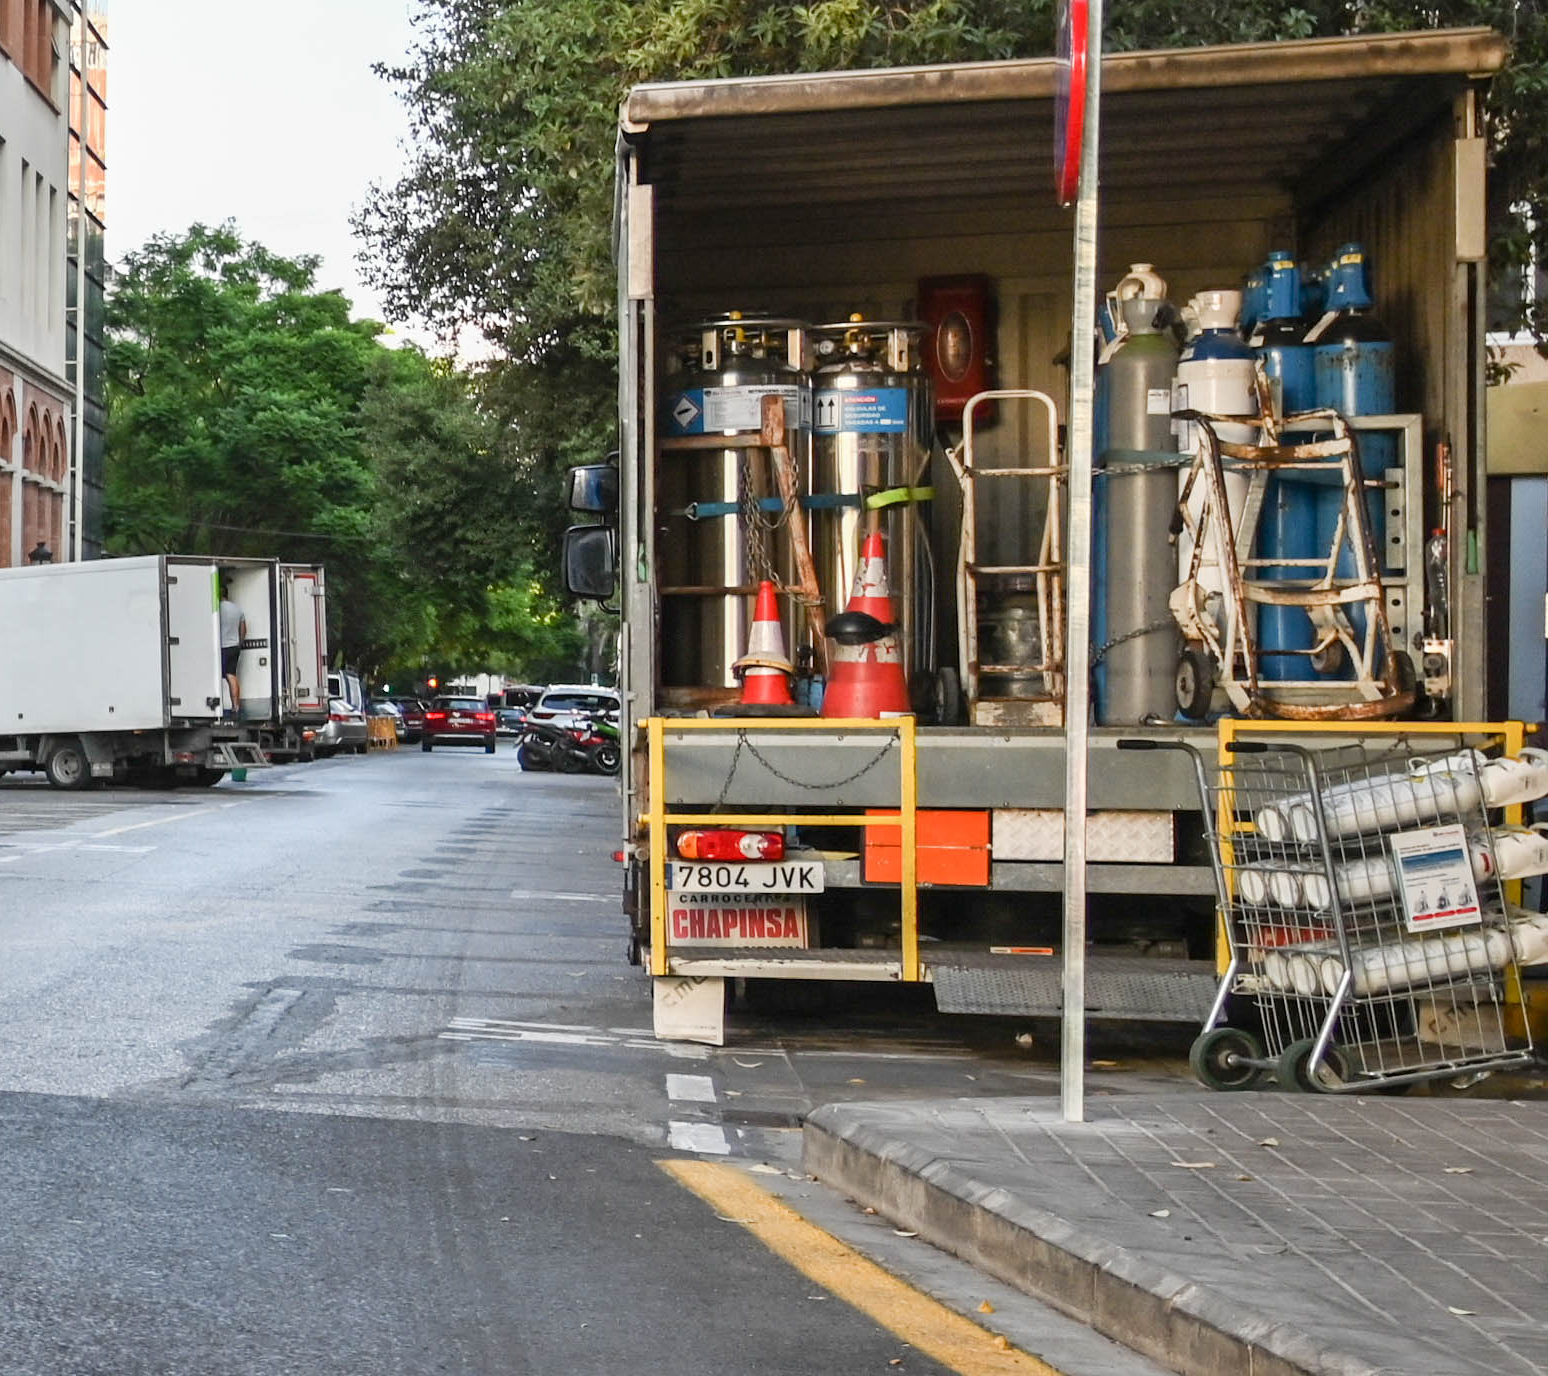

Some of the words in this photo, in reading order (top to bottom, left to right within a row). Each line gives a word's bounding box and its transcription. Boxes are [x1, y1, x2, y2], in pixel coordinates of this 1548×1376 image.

[679, 866, 750, 888] 7804
[762, 866, 815, 888] JVK
[673, 908, 800, 939] CHAPINSA
